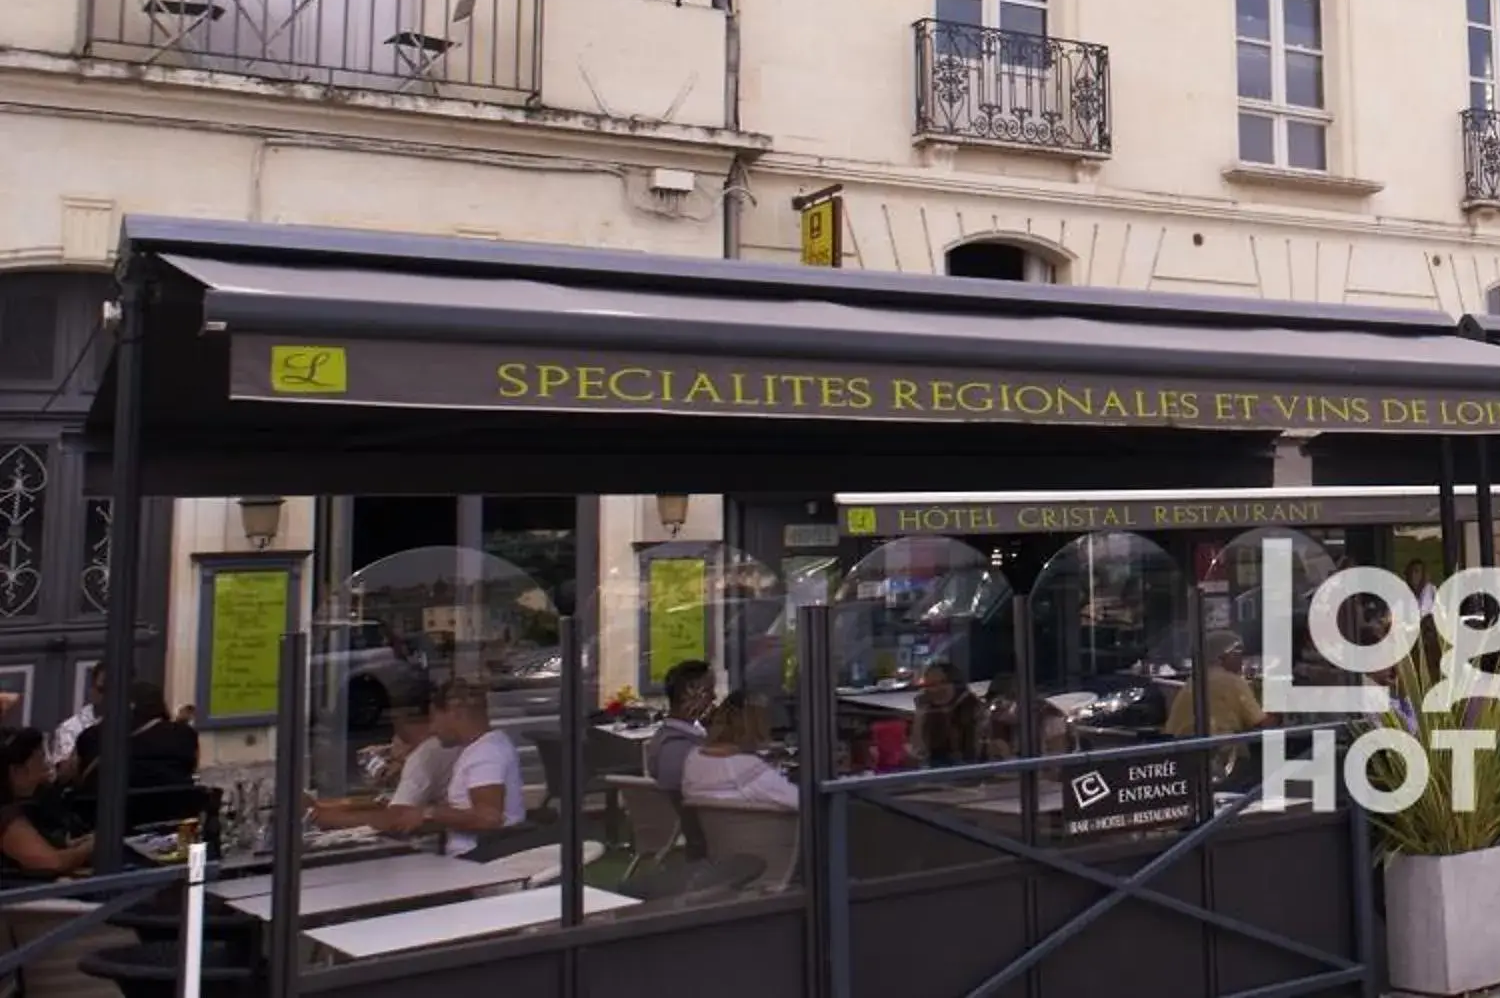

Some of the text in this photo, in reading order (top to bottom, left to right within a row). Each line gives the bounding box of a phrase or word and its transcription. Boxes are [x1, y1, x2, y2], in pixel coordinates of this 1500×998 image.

[497, 362, 872, 408] SPECIALITES
[892, 379, 1199, 420] REGIONALES
[1215, 392, 1258, 421] ET
[1273, 395, 1369, 424] VINS
[1382, 399, 1430, 425] DE
[899, 502, 1323, 531] HÔTEL CRISTAL RESTAURANT
[1128, 759, 1177, 781] ENTRÉE
[1118, 780, 1188, 803] ENTRANCE
